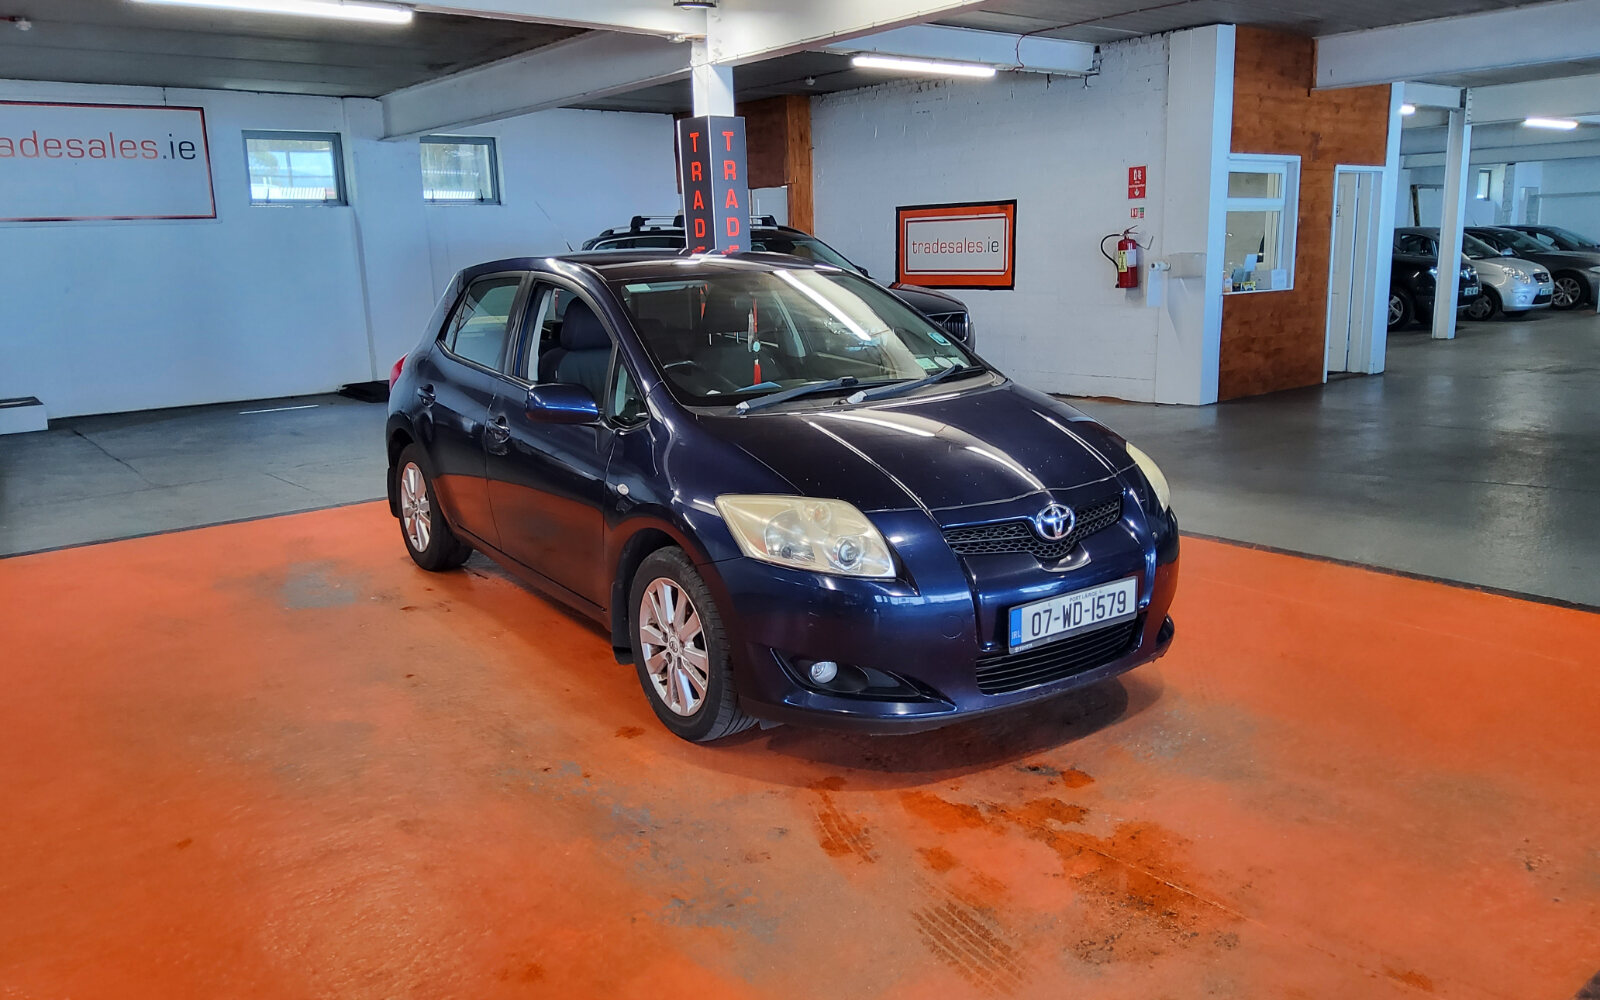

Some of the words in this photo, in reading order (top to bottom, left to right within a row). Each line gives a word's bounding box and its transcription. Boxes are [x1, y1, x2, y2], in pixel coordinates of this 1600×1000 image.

[0, 130, 196, 160] adesales.ie
[912, 236, 999, 254] tradesales.ie
[1031, 590, 1127, 637] 07-WD-1579
[1011, 629, 1022, 640] IRL
